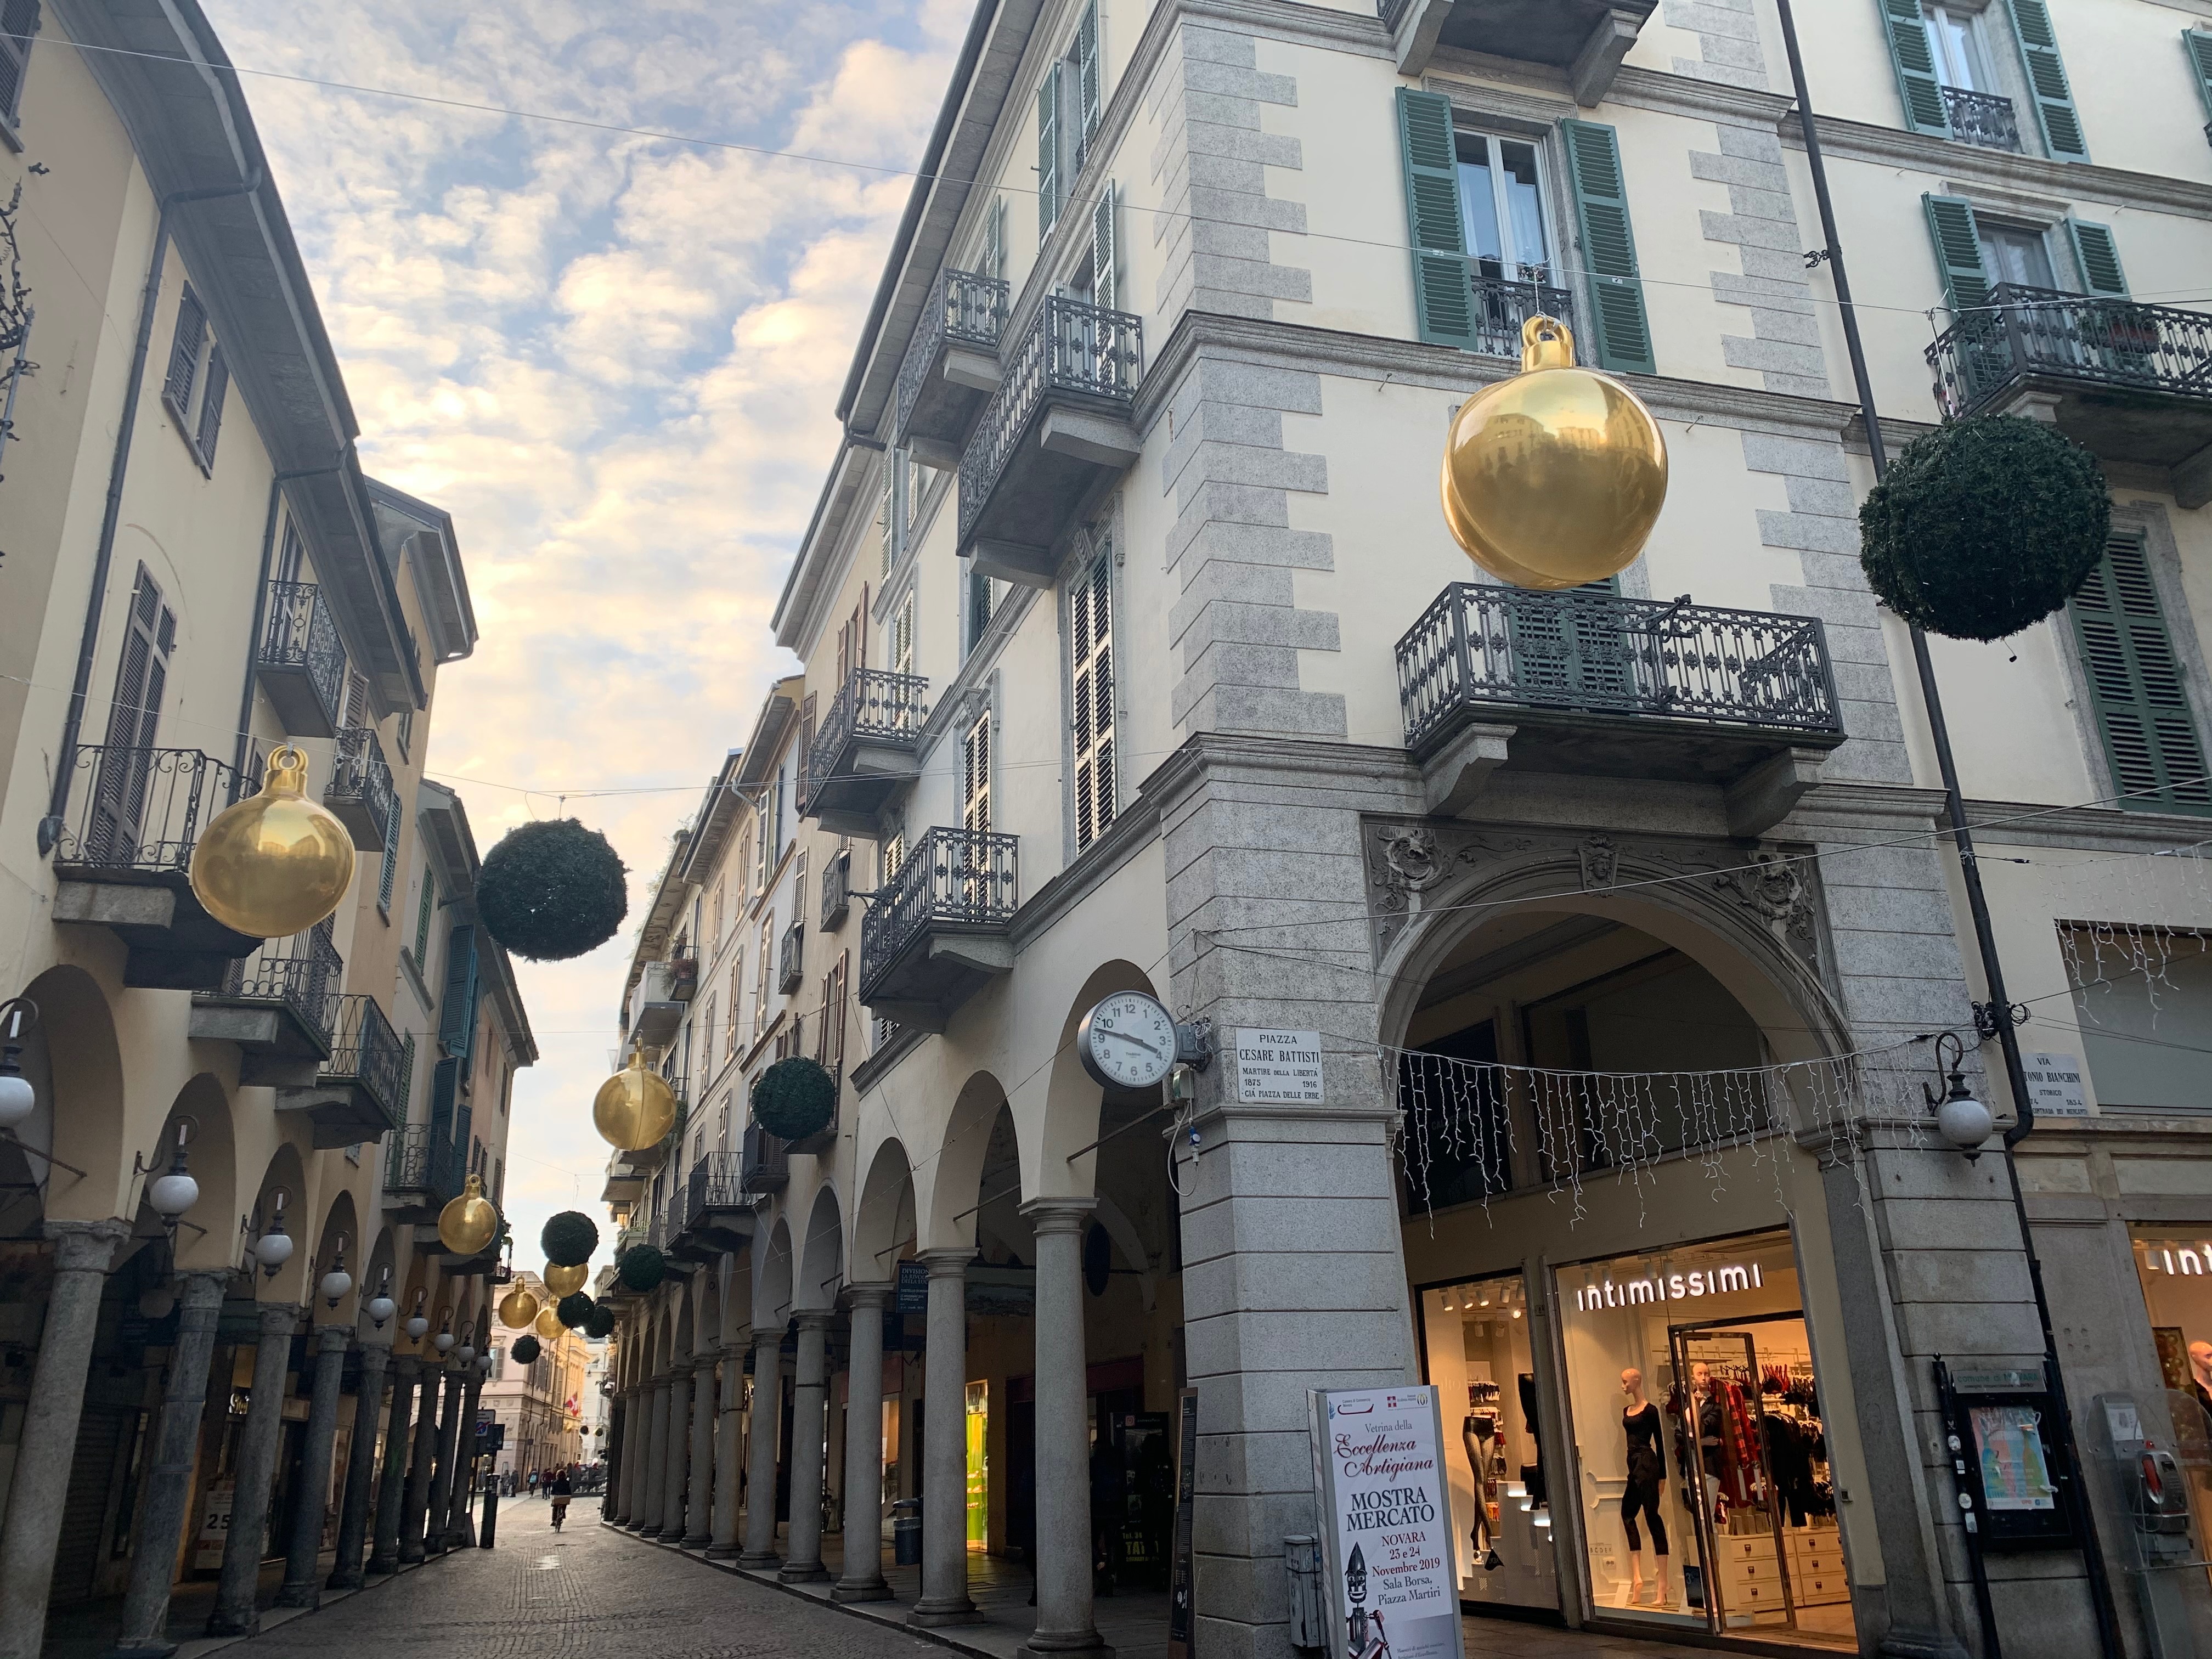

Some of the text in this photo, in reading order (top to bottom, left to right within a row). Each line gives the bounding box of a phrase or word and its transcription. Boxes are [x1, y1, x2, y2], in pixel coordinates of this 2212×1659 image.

[1112, 1008, 1121, 1017] 11
[1125, 1004, 1136, 1014] 12
[1143, 1009, 1147, 1018] 1
[1102, 1019, 1114, 1028] 10
[1154, 1020, 1161, 1030] 2
[1098, 1034, 1105, 1043] 9
[1159, 1036, 1166, 1046] 3
[1260, 1034, 1297, 1044] PIAZZA
[1103, 1049, 1110, 1059] 8
[1156, 1051, 1163, 1060] 4
[1239, 1049, 1319, 1063] CESARE BATTISTI
[1116, 1062, 1122, 1071] 7
[1130, 1066, 1138, 1076] 6
[1146, 1063, 1152, 1072] 5
[2024, 1071, 2080, 1083] TONIO BIANCHINI
[1577, 1263, 1762, 1312] intimissimi
[2004, 1373, 2039, 1382] NVARA
[1365, 1419, 1412, 1433] Vetrina della
[1334, 1433, 1417, 1458] Eccellenza
[1345, 1454, 1434, 1482] Artigiana
[1351, 1486, 1427, 1511] MOSTRA
[1346, 1504, 1435, 1532] MERCATO
[1381, 1531, 1426, 1547] NOVARA
[1389, 1549, 1400, 1560] 23
[1409, 1545, 1420, 1557] 24
[1372, 1557, 1440, 1577] Novembre 2019
[1383, 1576, 1432, 1590] Sala Borsa,
[1378, 1586, 1441, 1605] Piazza Martiri
